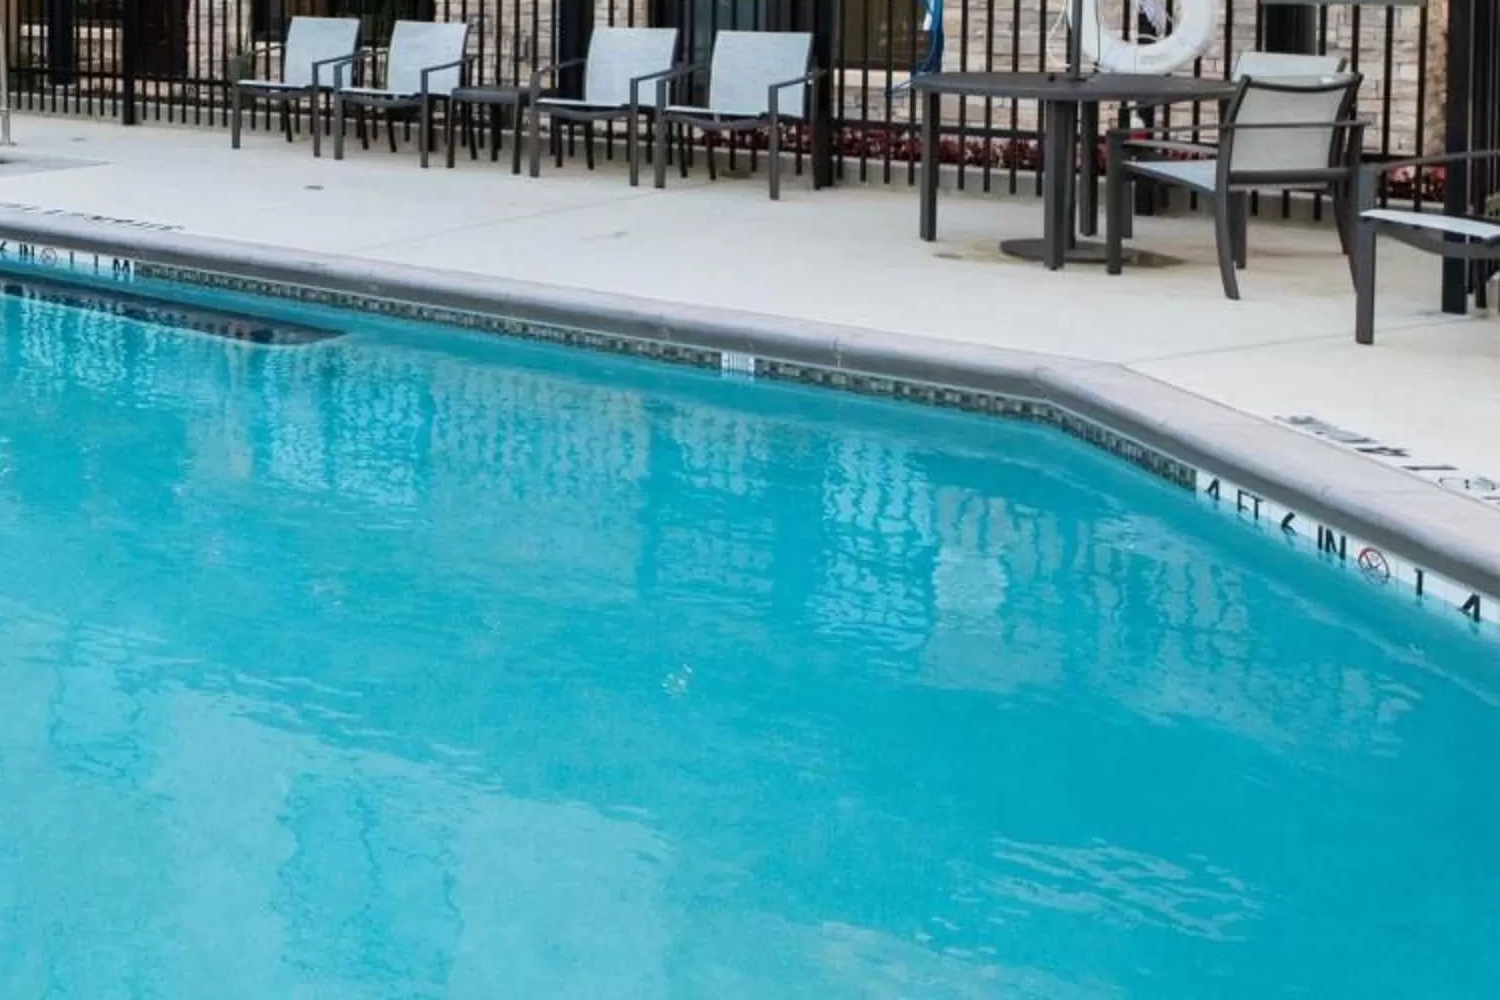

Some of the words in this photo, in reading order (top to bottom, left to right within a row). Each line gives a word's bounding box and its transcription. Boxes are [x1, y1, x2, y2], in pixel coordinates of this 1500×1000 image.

[19, 243, 36, 258] IN
[1237, 487, 1264, 521] FT
[1317, 524, 1347, 561] IN
